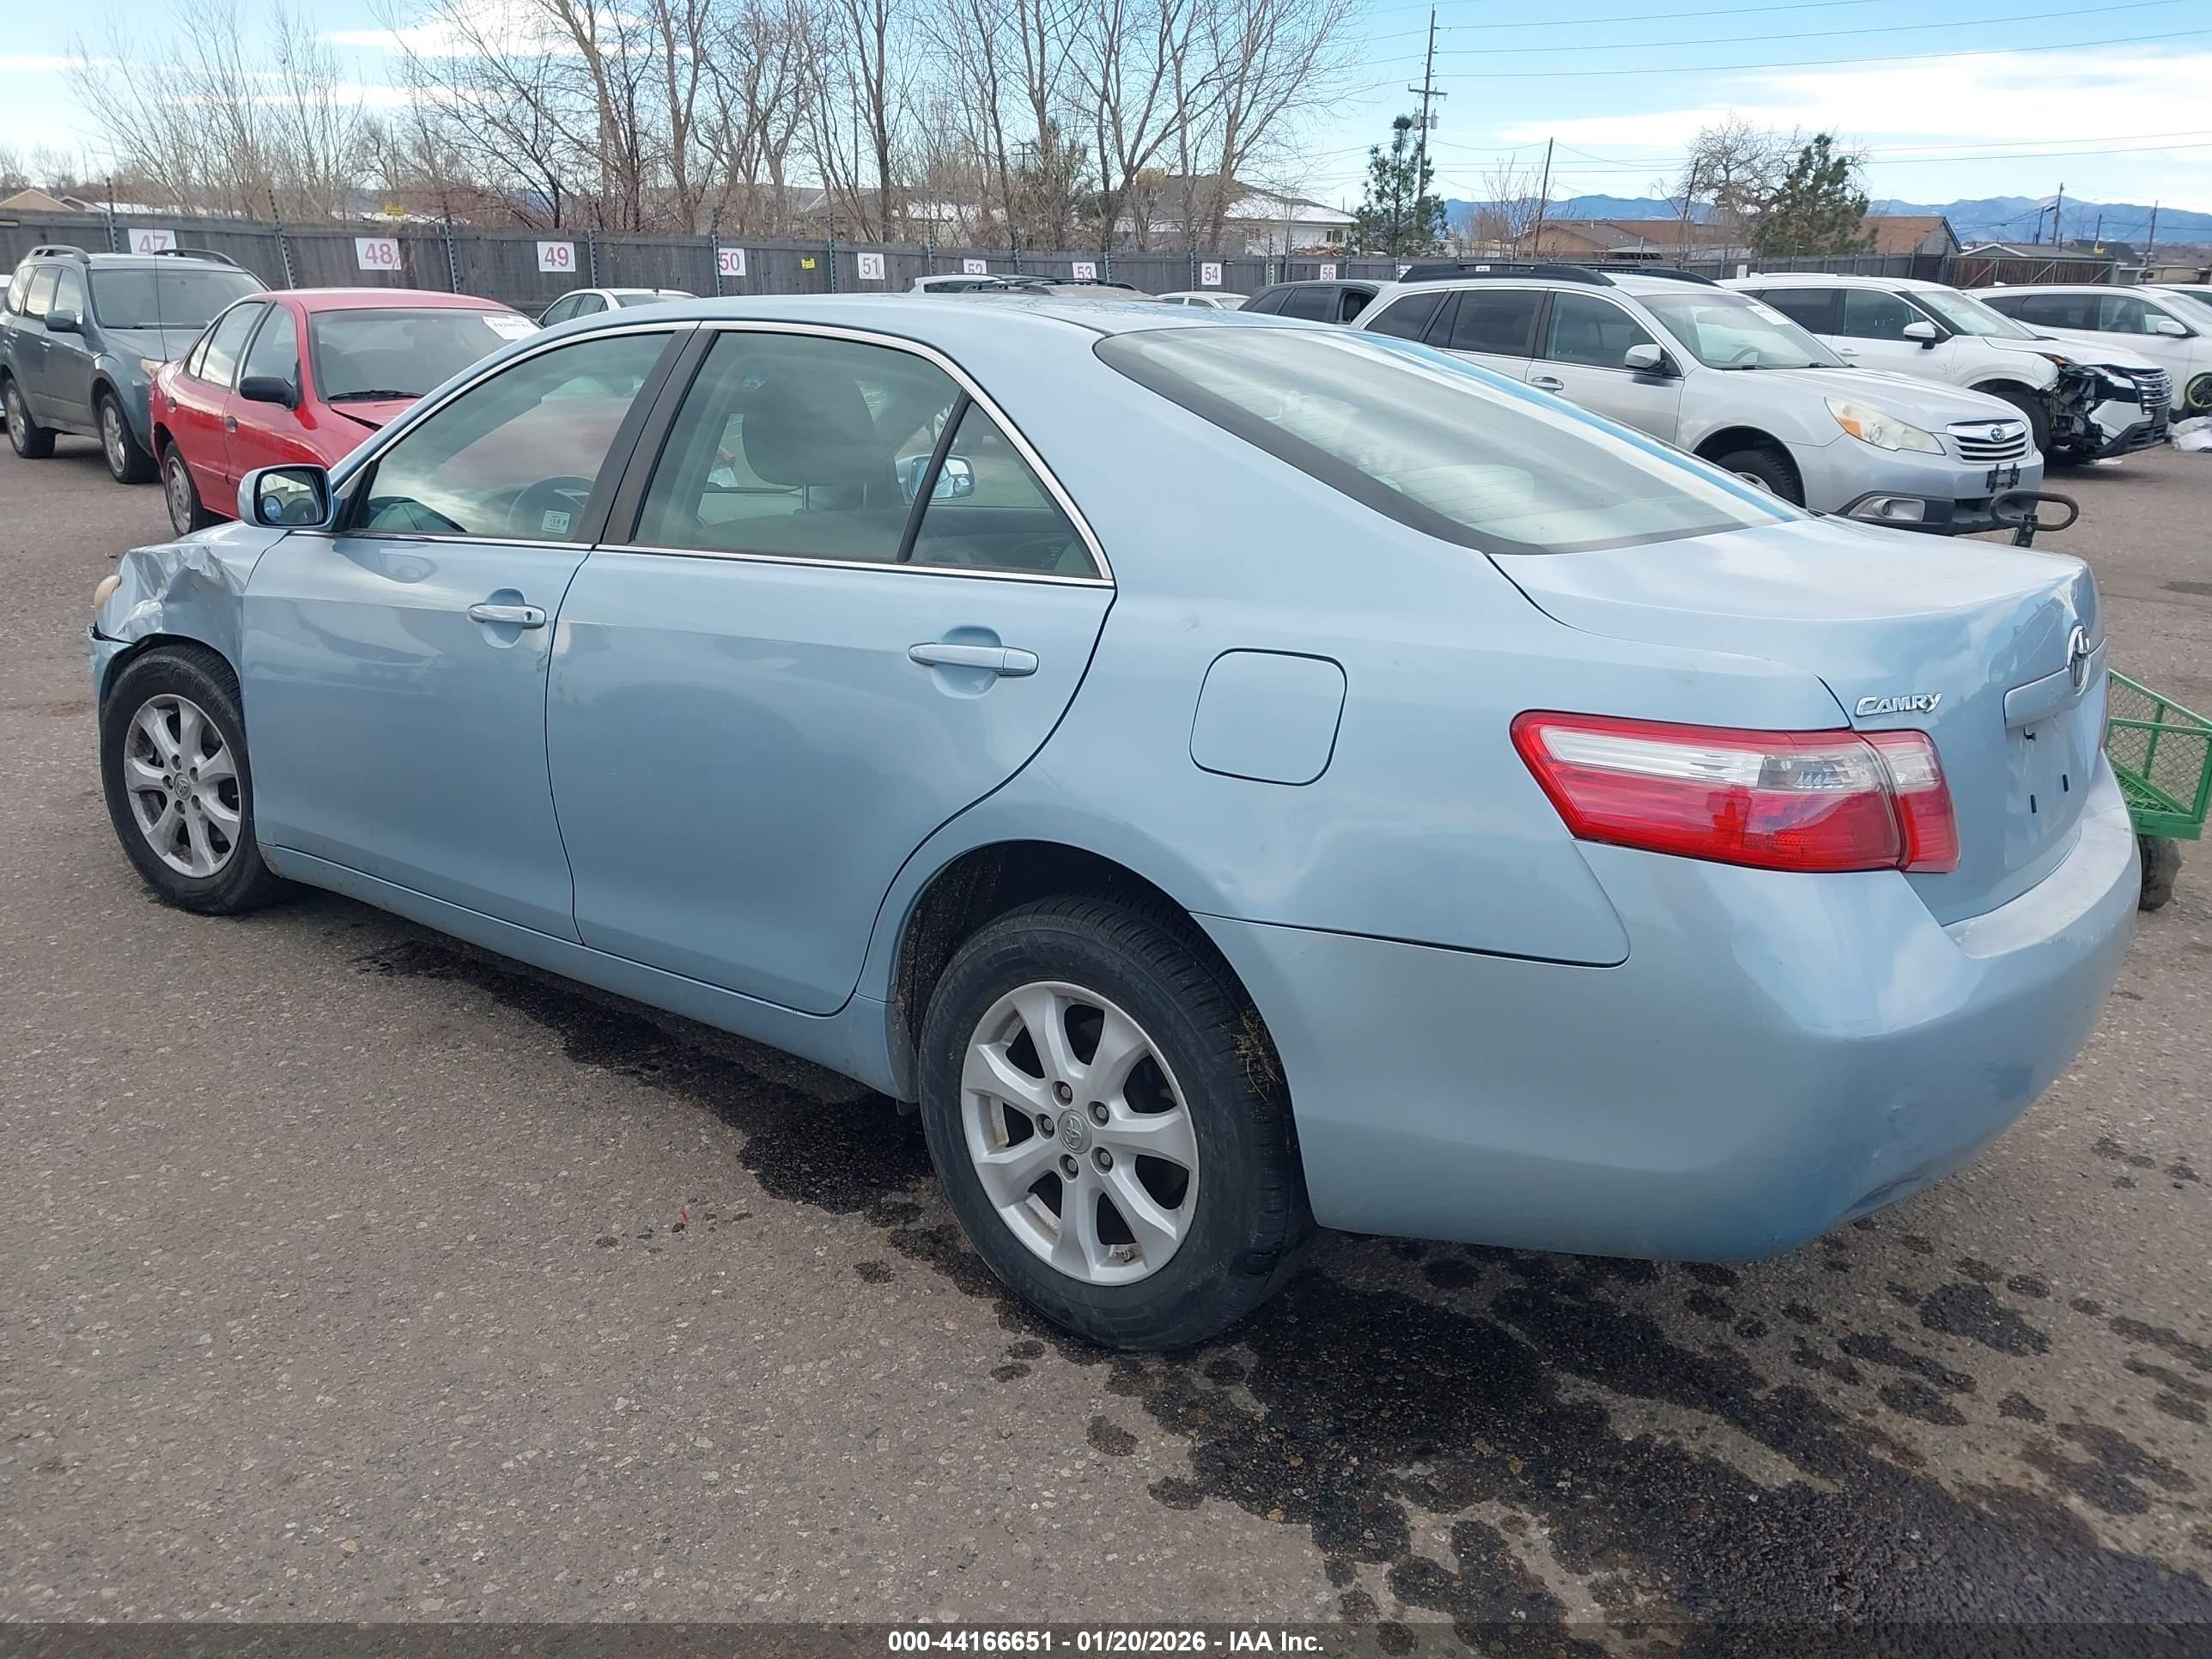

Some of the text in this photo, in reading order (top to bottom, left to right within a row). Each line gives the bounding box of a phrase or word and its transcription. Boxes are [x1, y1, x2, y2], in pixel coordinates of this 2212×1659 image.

[138, 234, 167, 255] 47
[365, 243, 393, 264] 48
[544, 246, 569, 267] 49
[719, 252, 740, 270] 50
[863, 257, 878, 275] 51
[1078, 265, 1093, 279] 53
[1205, 266, 1218, 281] 54
[1322, 267, 1334, 280] 56
[1855, 693, 1942, 716] CAMRY
